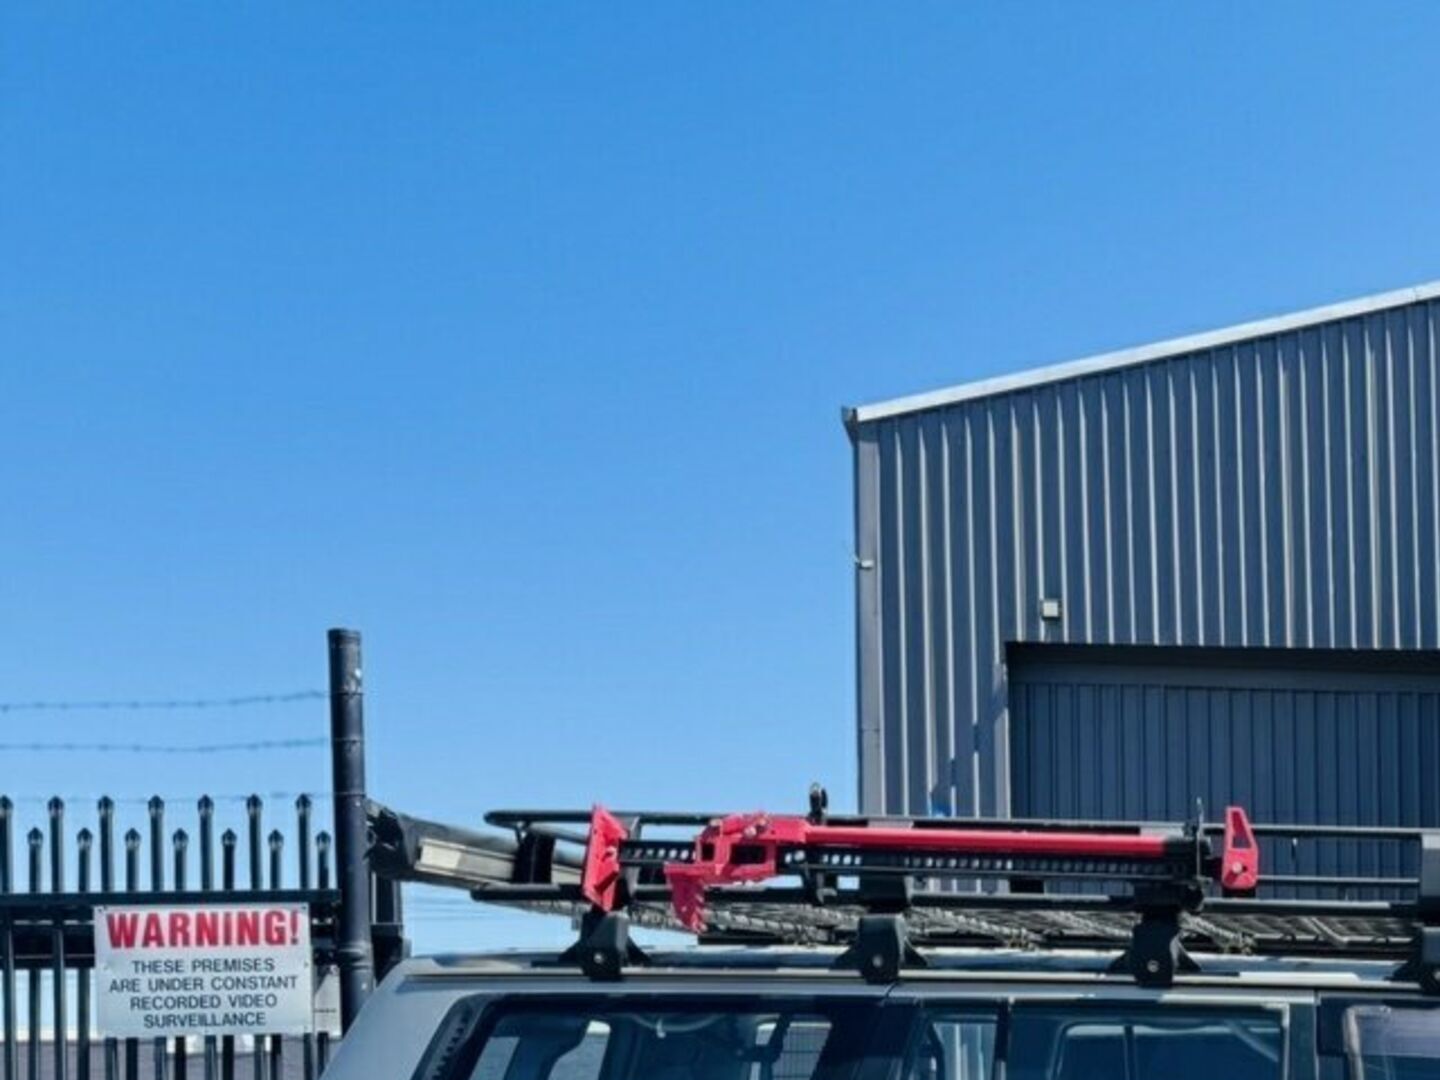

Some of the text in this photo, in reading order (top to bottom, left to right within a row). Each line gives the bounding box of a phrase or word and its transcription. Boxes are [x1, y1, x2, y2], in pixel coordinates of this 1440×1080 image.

[106, 909, 299, 948] WARNING!
[132, 957, 275, 974] THESE PREMISES
[109, 975, 298, 993] ARE UNDER CONSTANT
[130, 993, 278, 1011] RECORDED VIDEO
[143, 1012, 266, 1029] SURVEILLANCE
